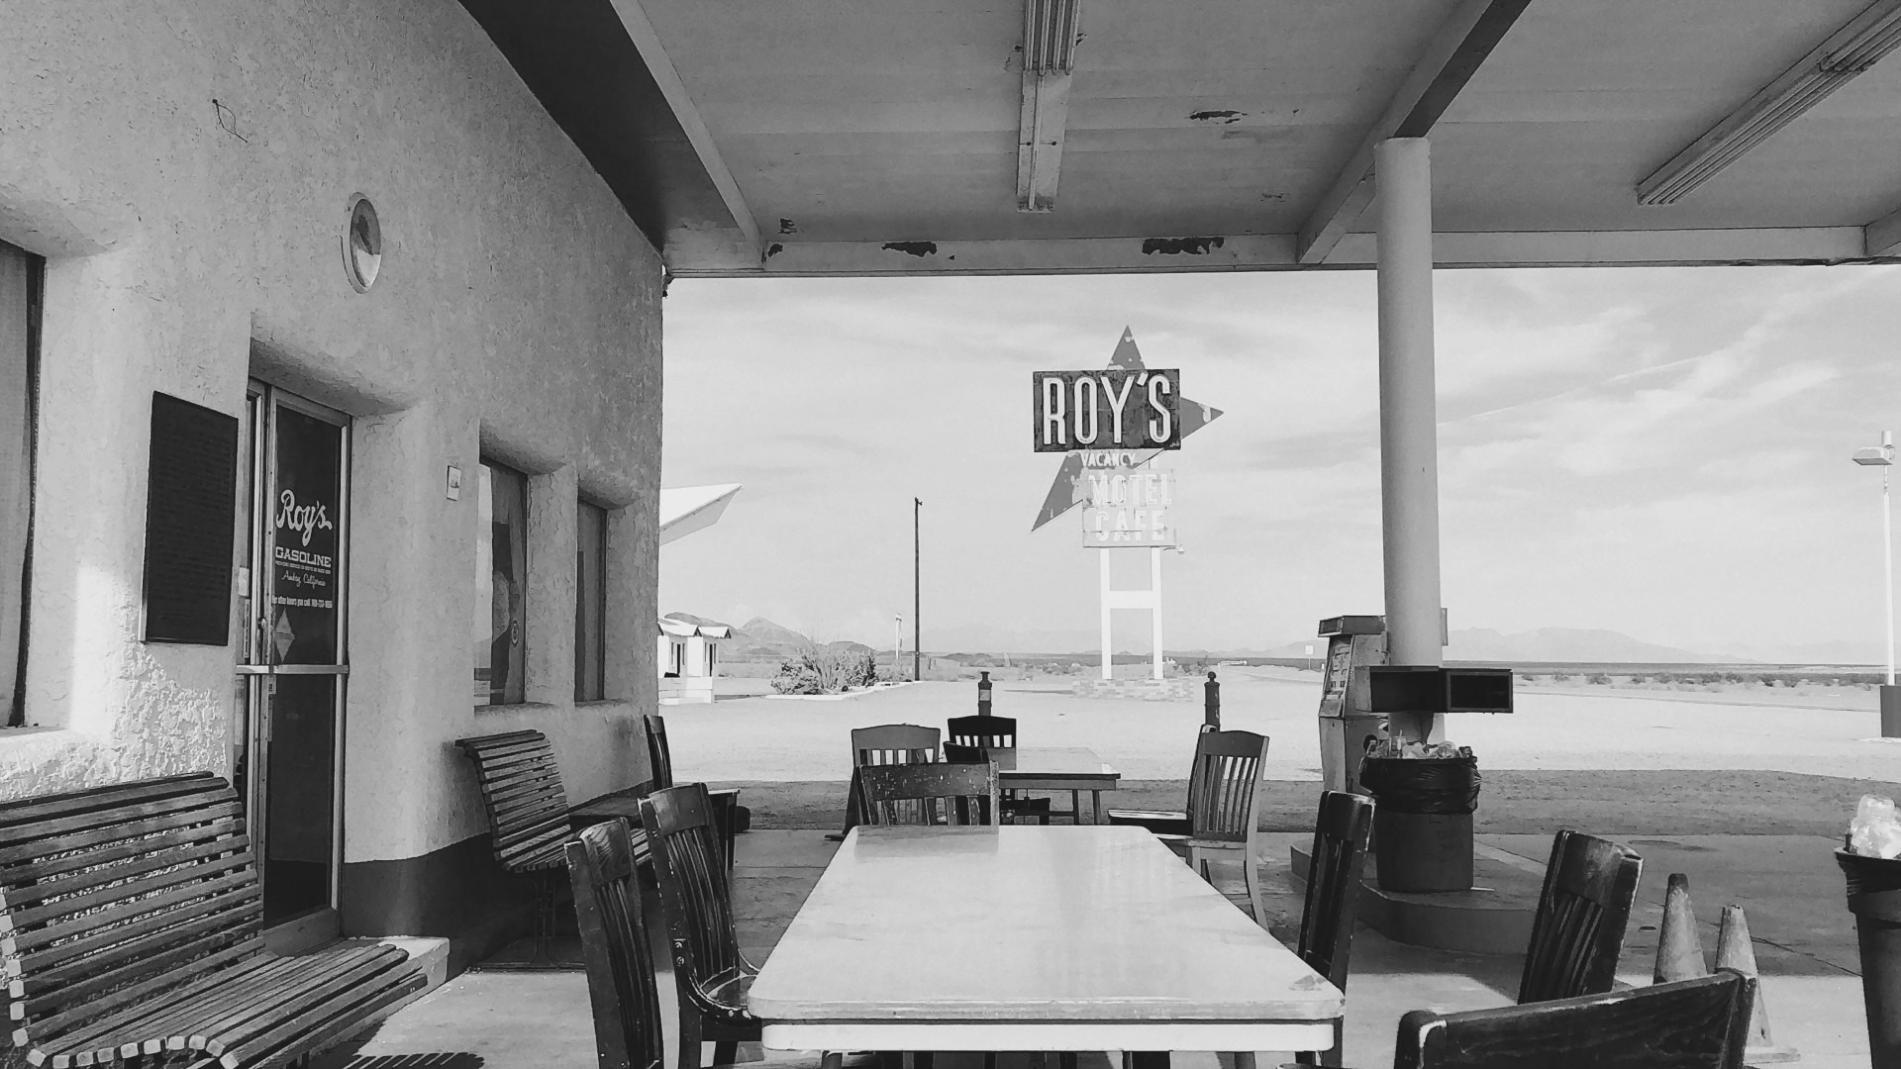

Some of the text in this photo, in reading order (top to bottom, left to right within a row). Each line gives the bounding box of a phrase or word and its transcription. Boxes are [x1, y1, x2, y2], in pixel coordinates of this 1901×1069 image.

[1043, 372, 1171, 445] ROY'S
[1081, 452, 1136, 467] VACANCY
[1088, 474, 1172, 505] MOTEL
[276, 489, 333, 547] Roy's
[1096, 510, 1165, 541] CAFE
[275, 546, 332, 567] GASOLINE
